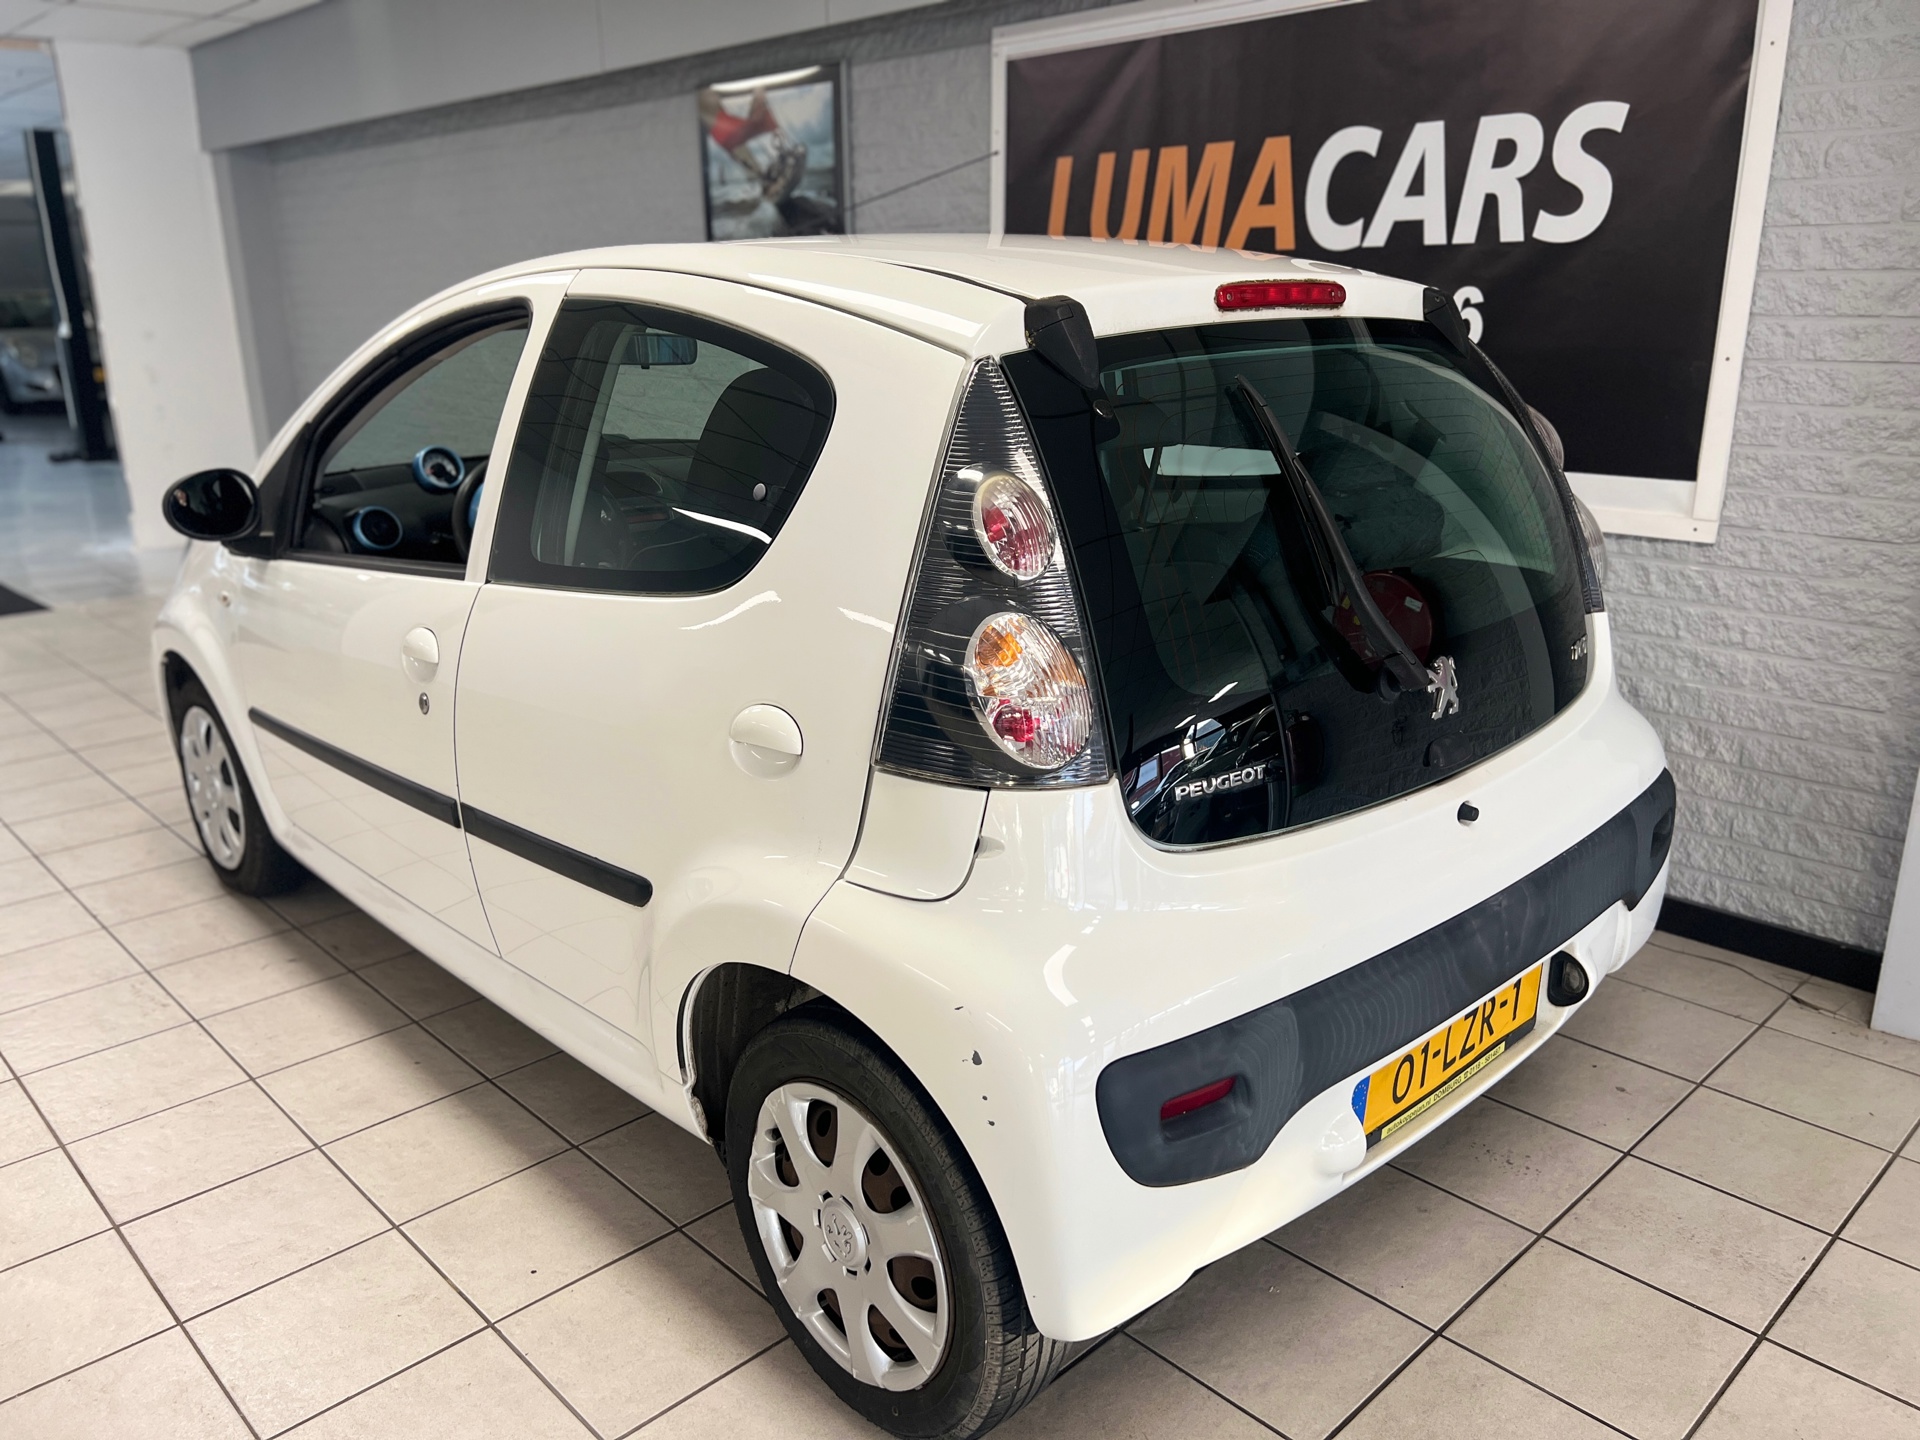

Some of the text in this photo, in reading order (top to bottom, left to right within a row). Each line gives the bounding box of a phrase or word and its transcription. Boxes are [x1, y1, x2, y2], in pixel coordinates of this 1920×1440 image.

[1174, 764, 1267, 802] PEUGEOT
[1391, 976, 1523, 1105] 01-LZR-1
[1433, 1076, 1462, 1102] DOMBURG
